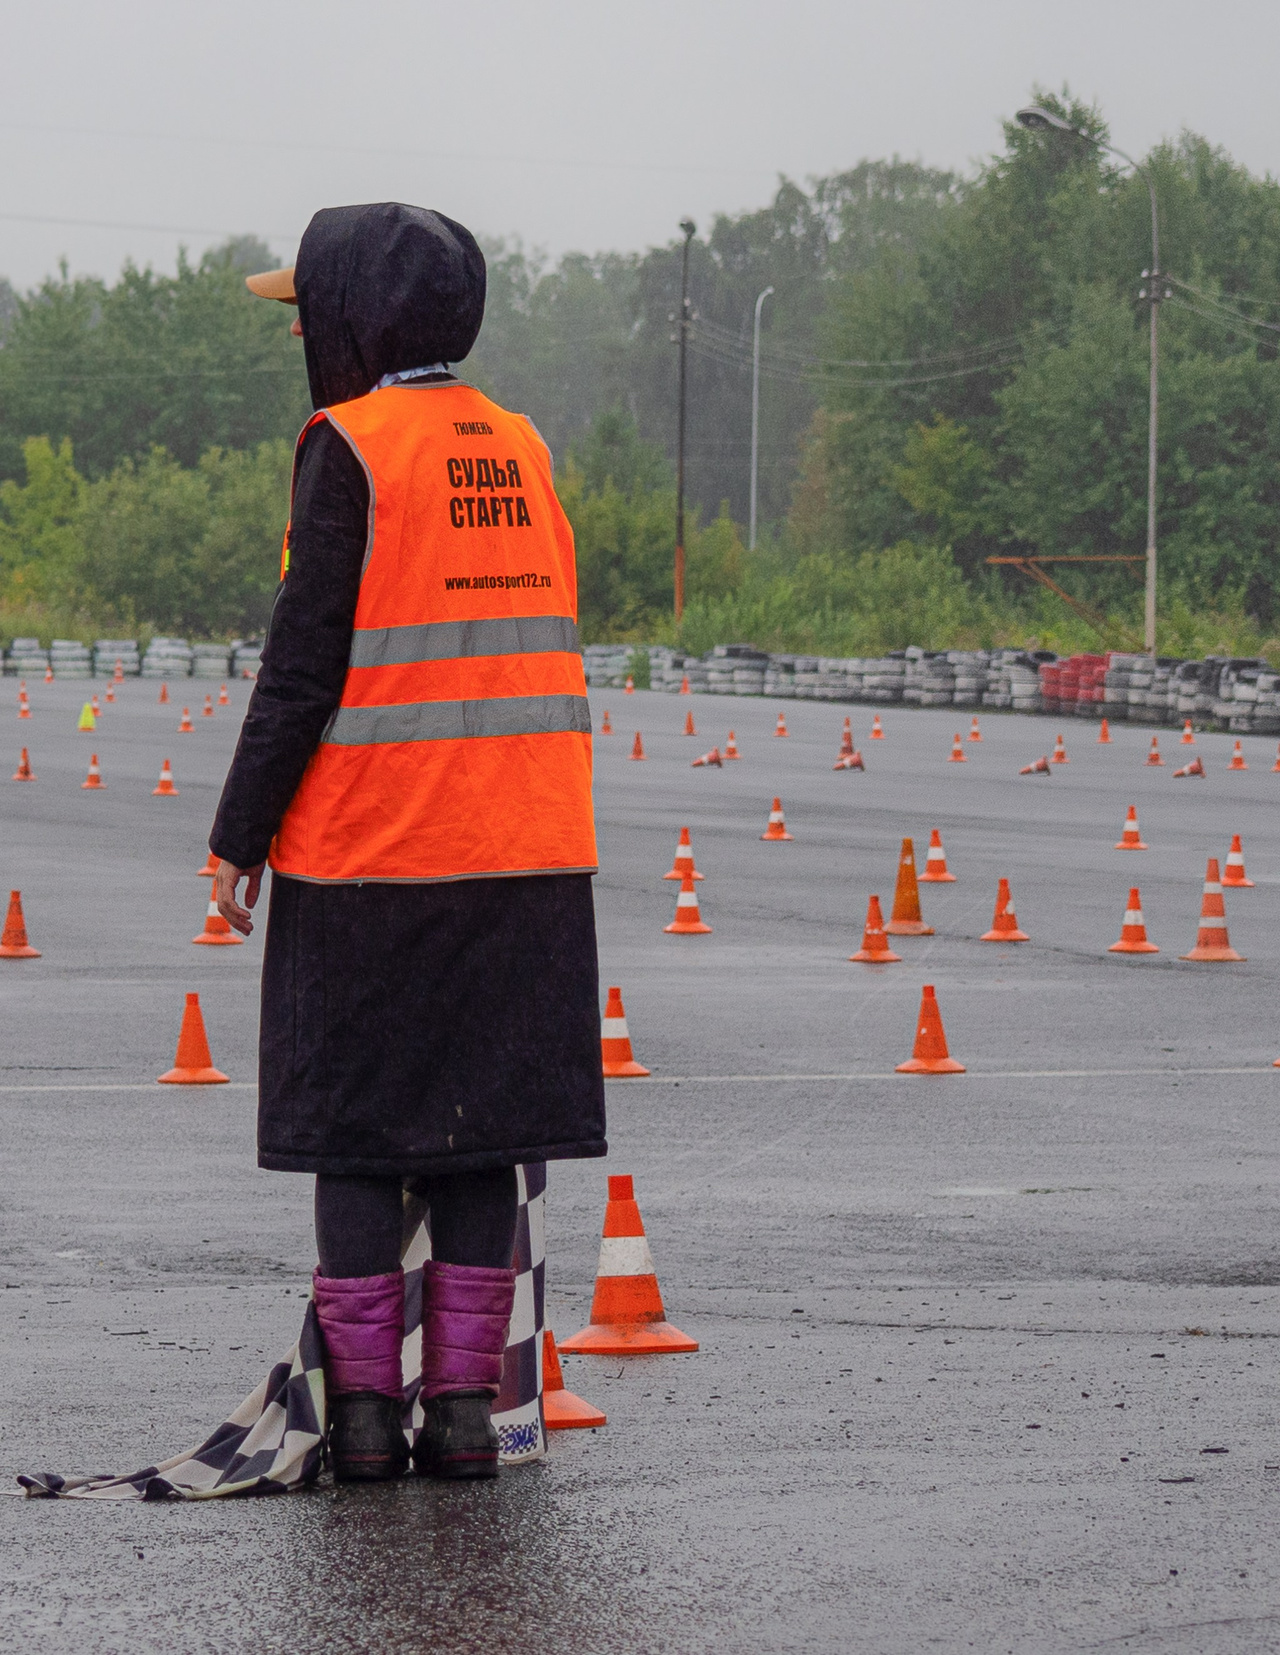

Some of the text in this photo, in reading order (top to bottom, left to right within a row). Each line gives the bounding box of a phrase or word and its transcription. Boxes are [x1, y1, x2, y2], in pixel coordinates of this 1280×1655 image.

[452, 421, 494, 437] ТЮМЕНЬ
[446, 457, 523, 493] СУДЬЯ
[449, 496, 533, 529] СТАРТА
[444, 572, 552, 591] www.autosport72.ru
